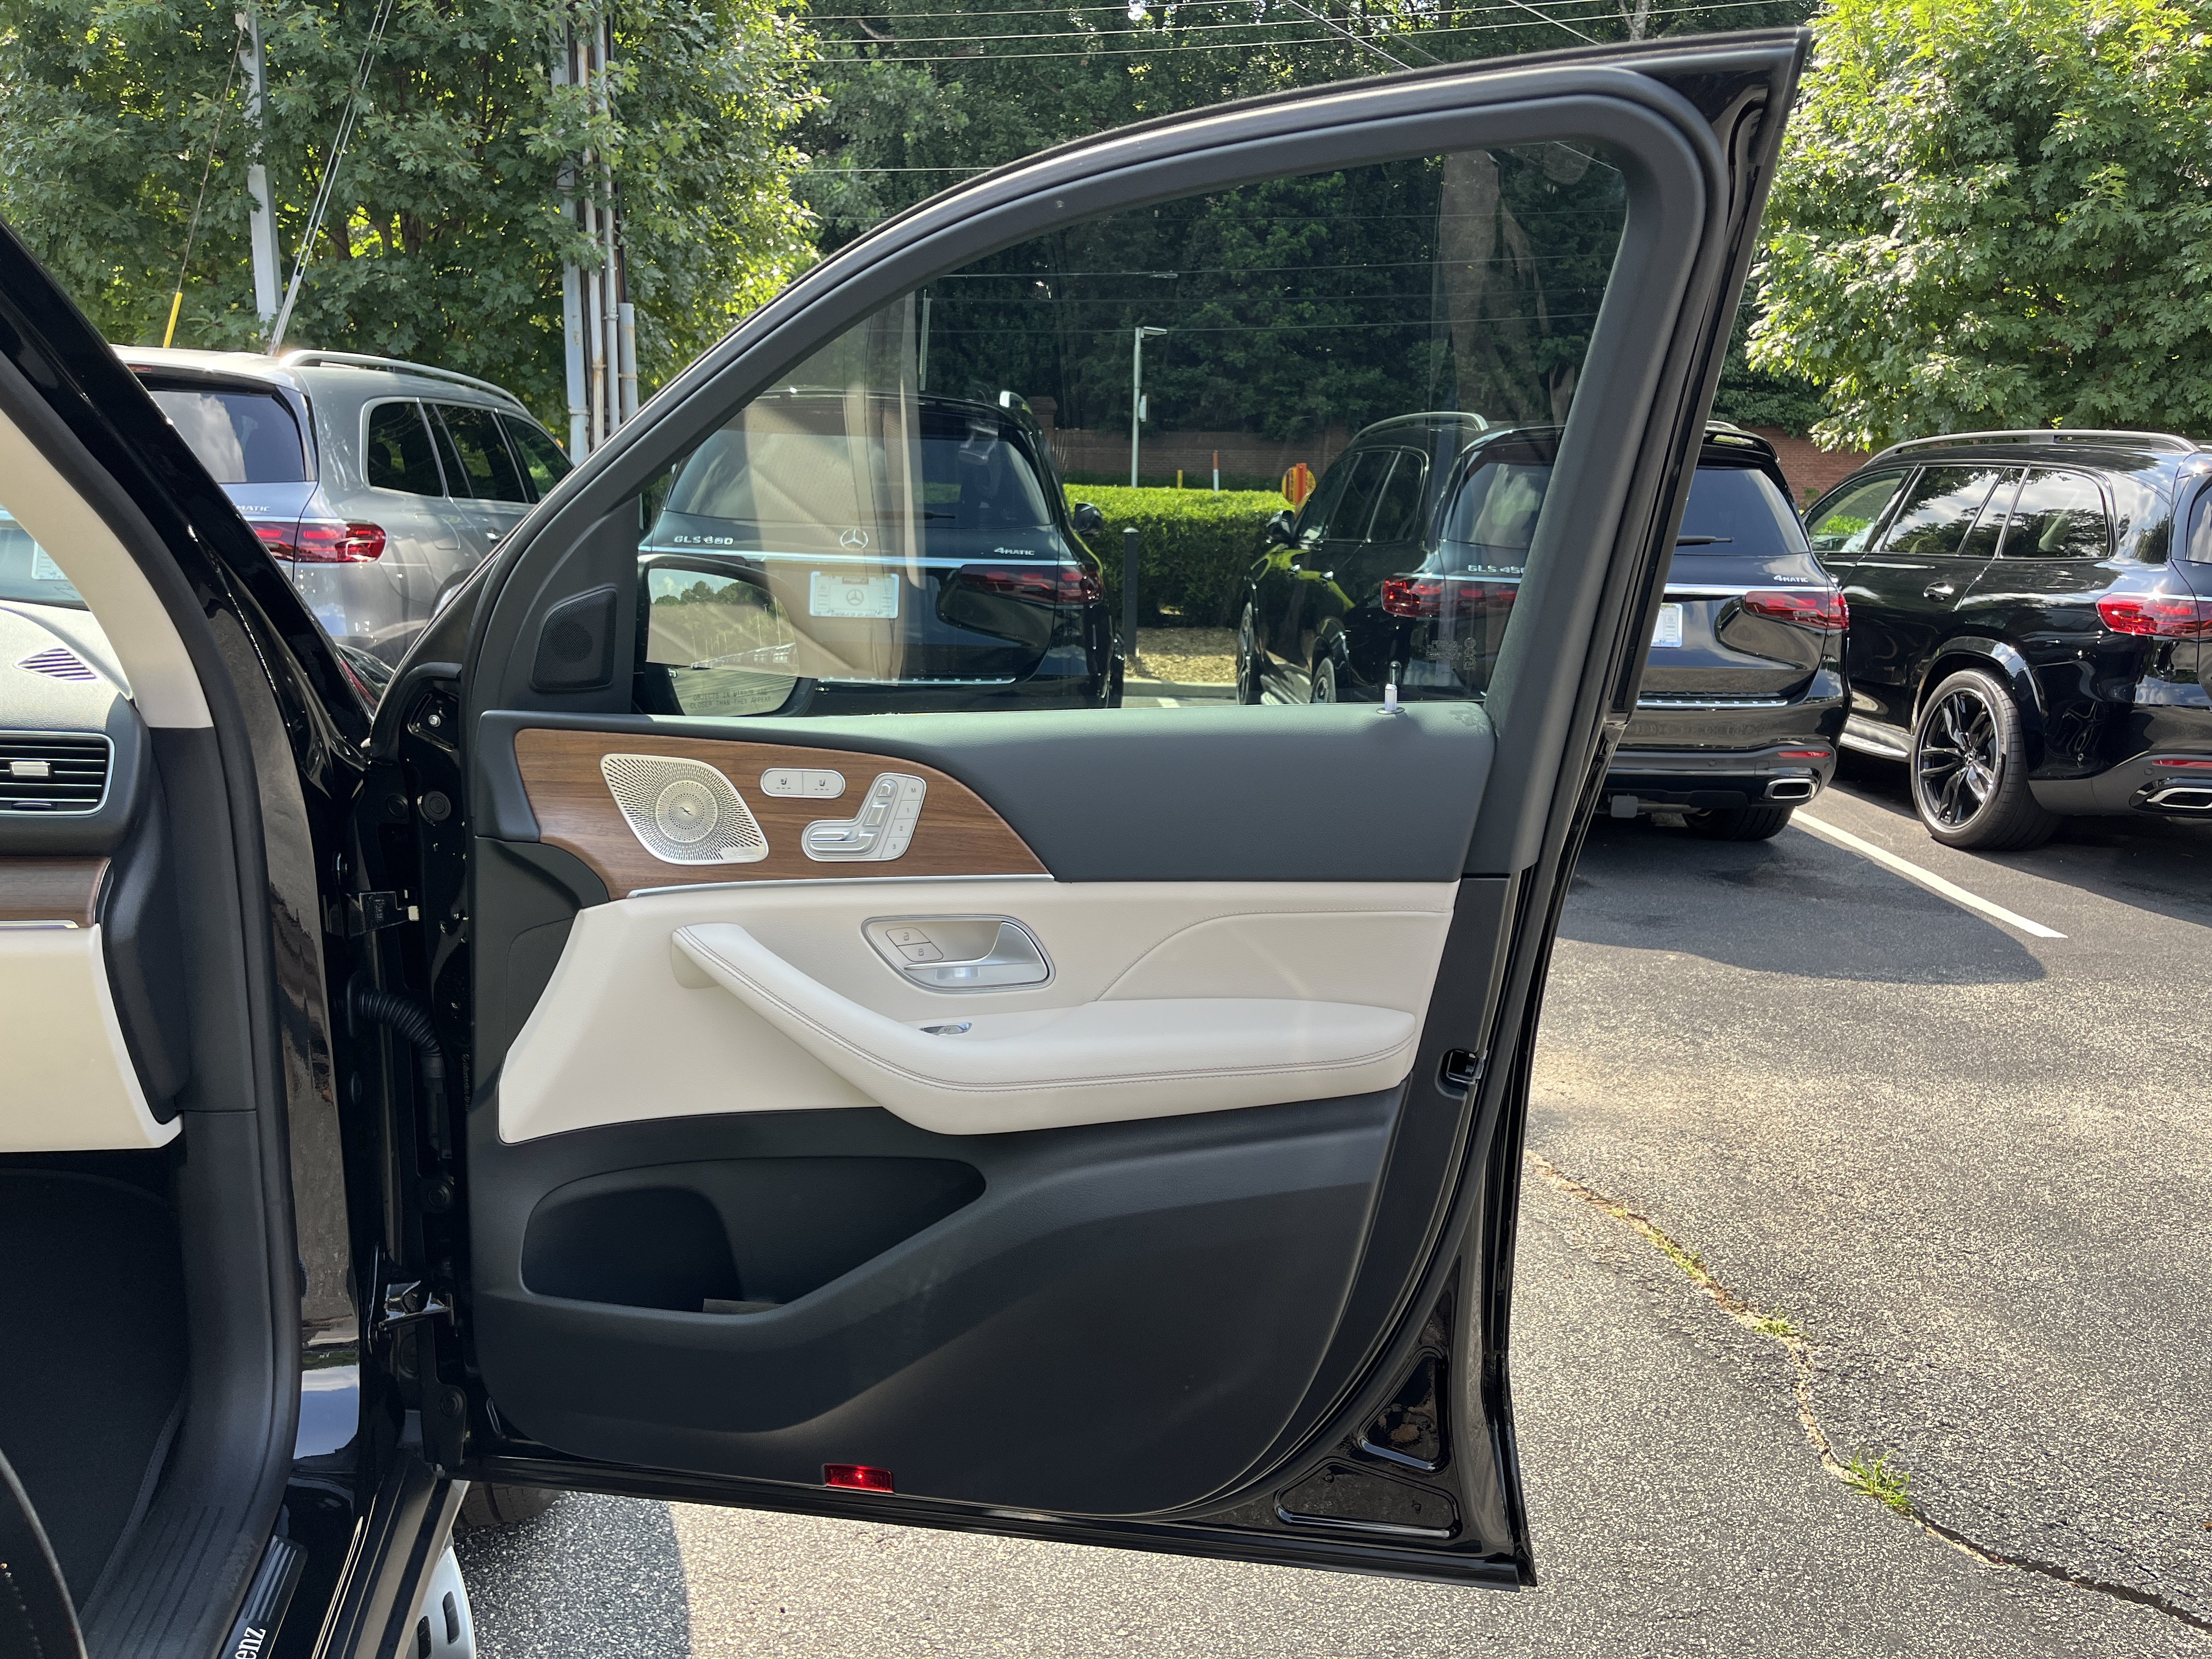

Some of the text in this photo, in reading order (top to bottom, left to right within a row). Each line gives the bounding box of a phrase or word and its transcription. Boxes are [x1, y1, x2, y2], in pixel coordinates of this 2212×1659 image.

[674, 535, 701, 544] GLS
[994, 547, 1036, 556] 4MATIC
[1468, 565, 1498, 573] GLS
[1773, 574, 1809, 583] 4MATIC
[693, 693, 719, 701] OBJECTS
[690, 701, 713, 709] CLOSER
